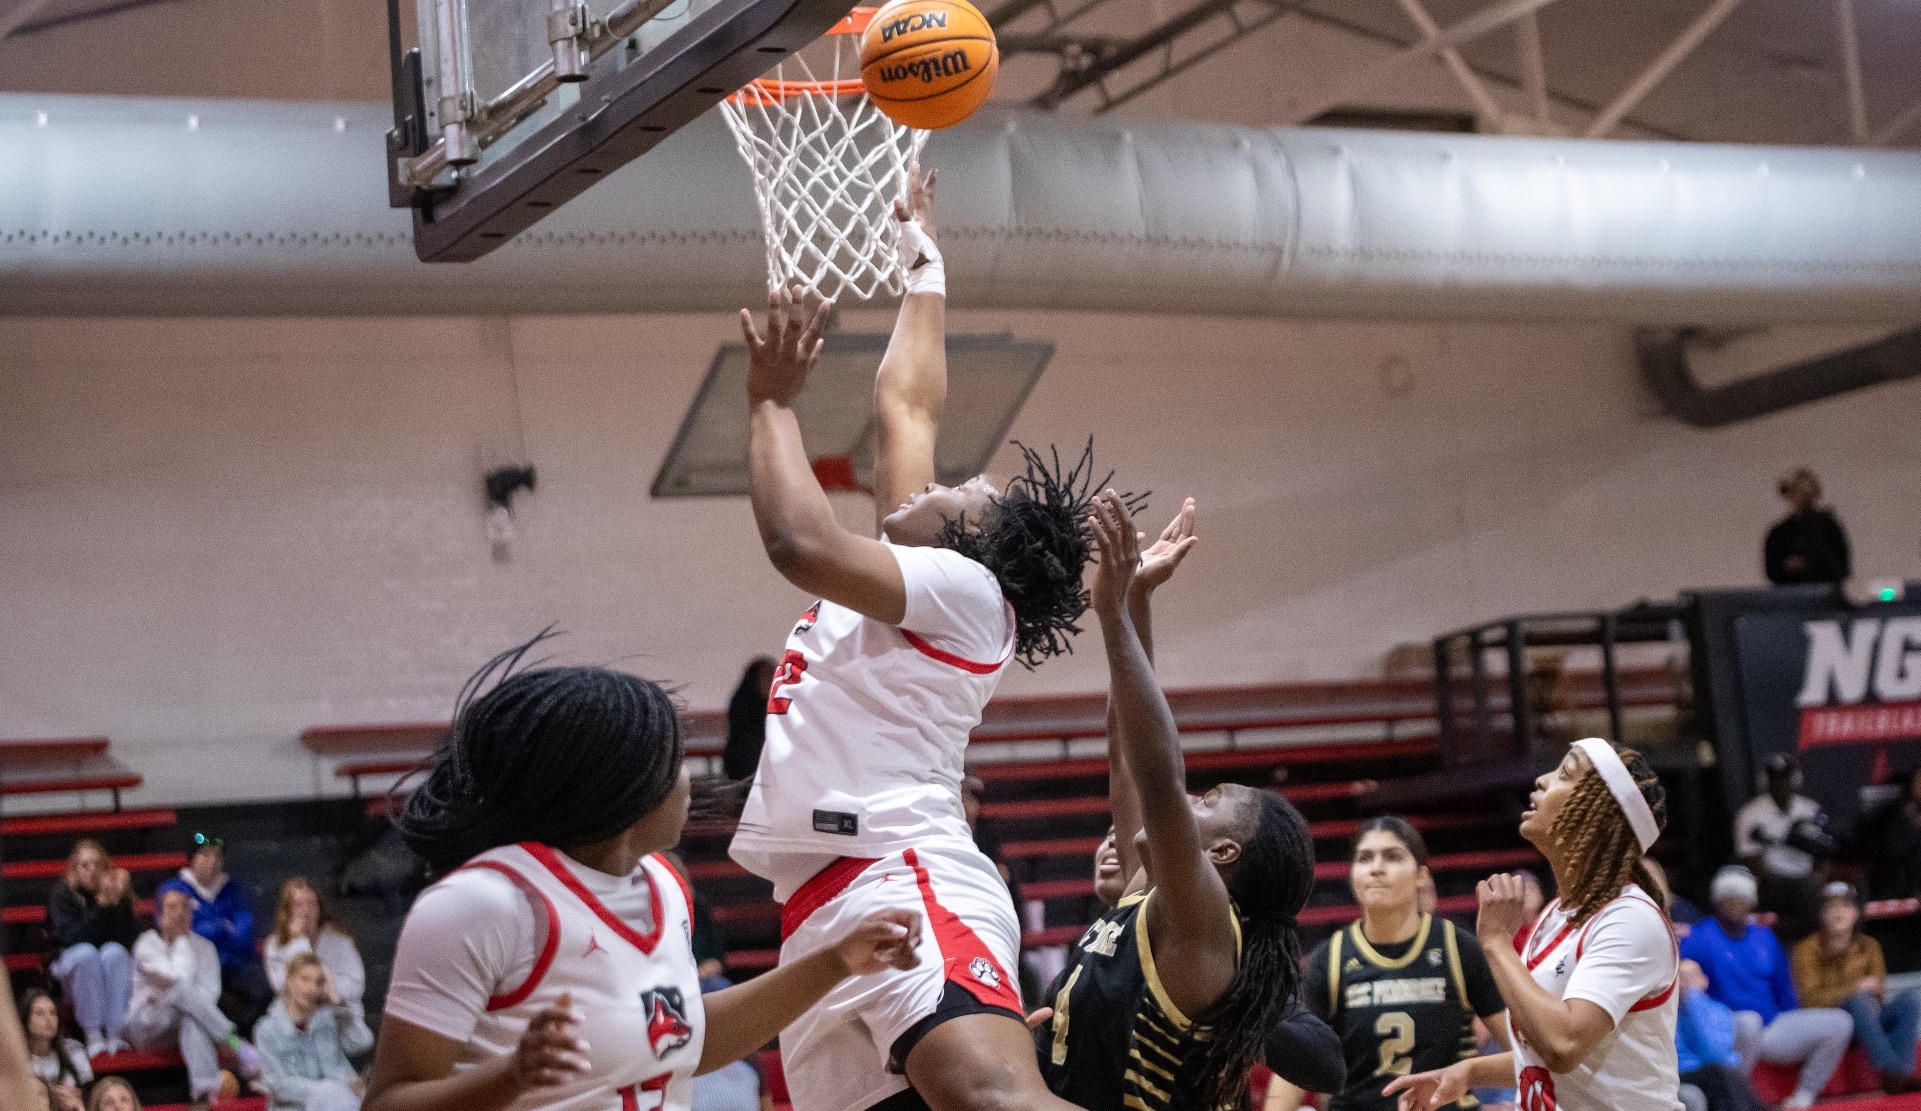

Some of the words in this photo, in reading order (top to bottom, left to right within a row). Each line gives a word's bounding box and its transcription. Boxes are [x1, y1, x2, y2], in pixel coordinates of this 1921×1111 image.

[881, 11, 948, 42] NCAA
[880, 48, 971, 83] Wilson
[1374, 1011, 1416, 1077] 2
